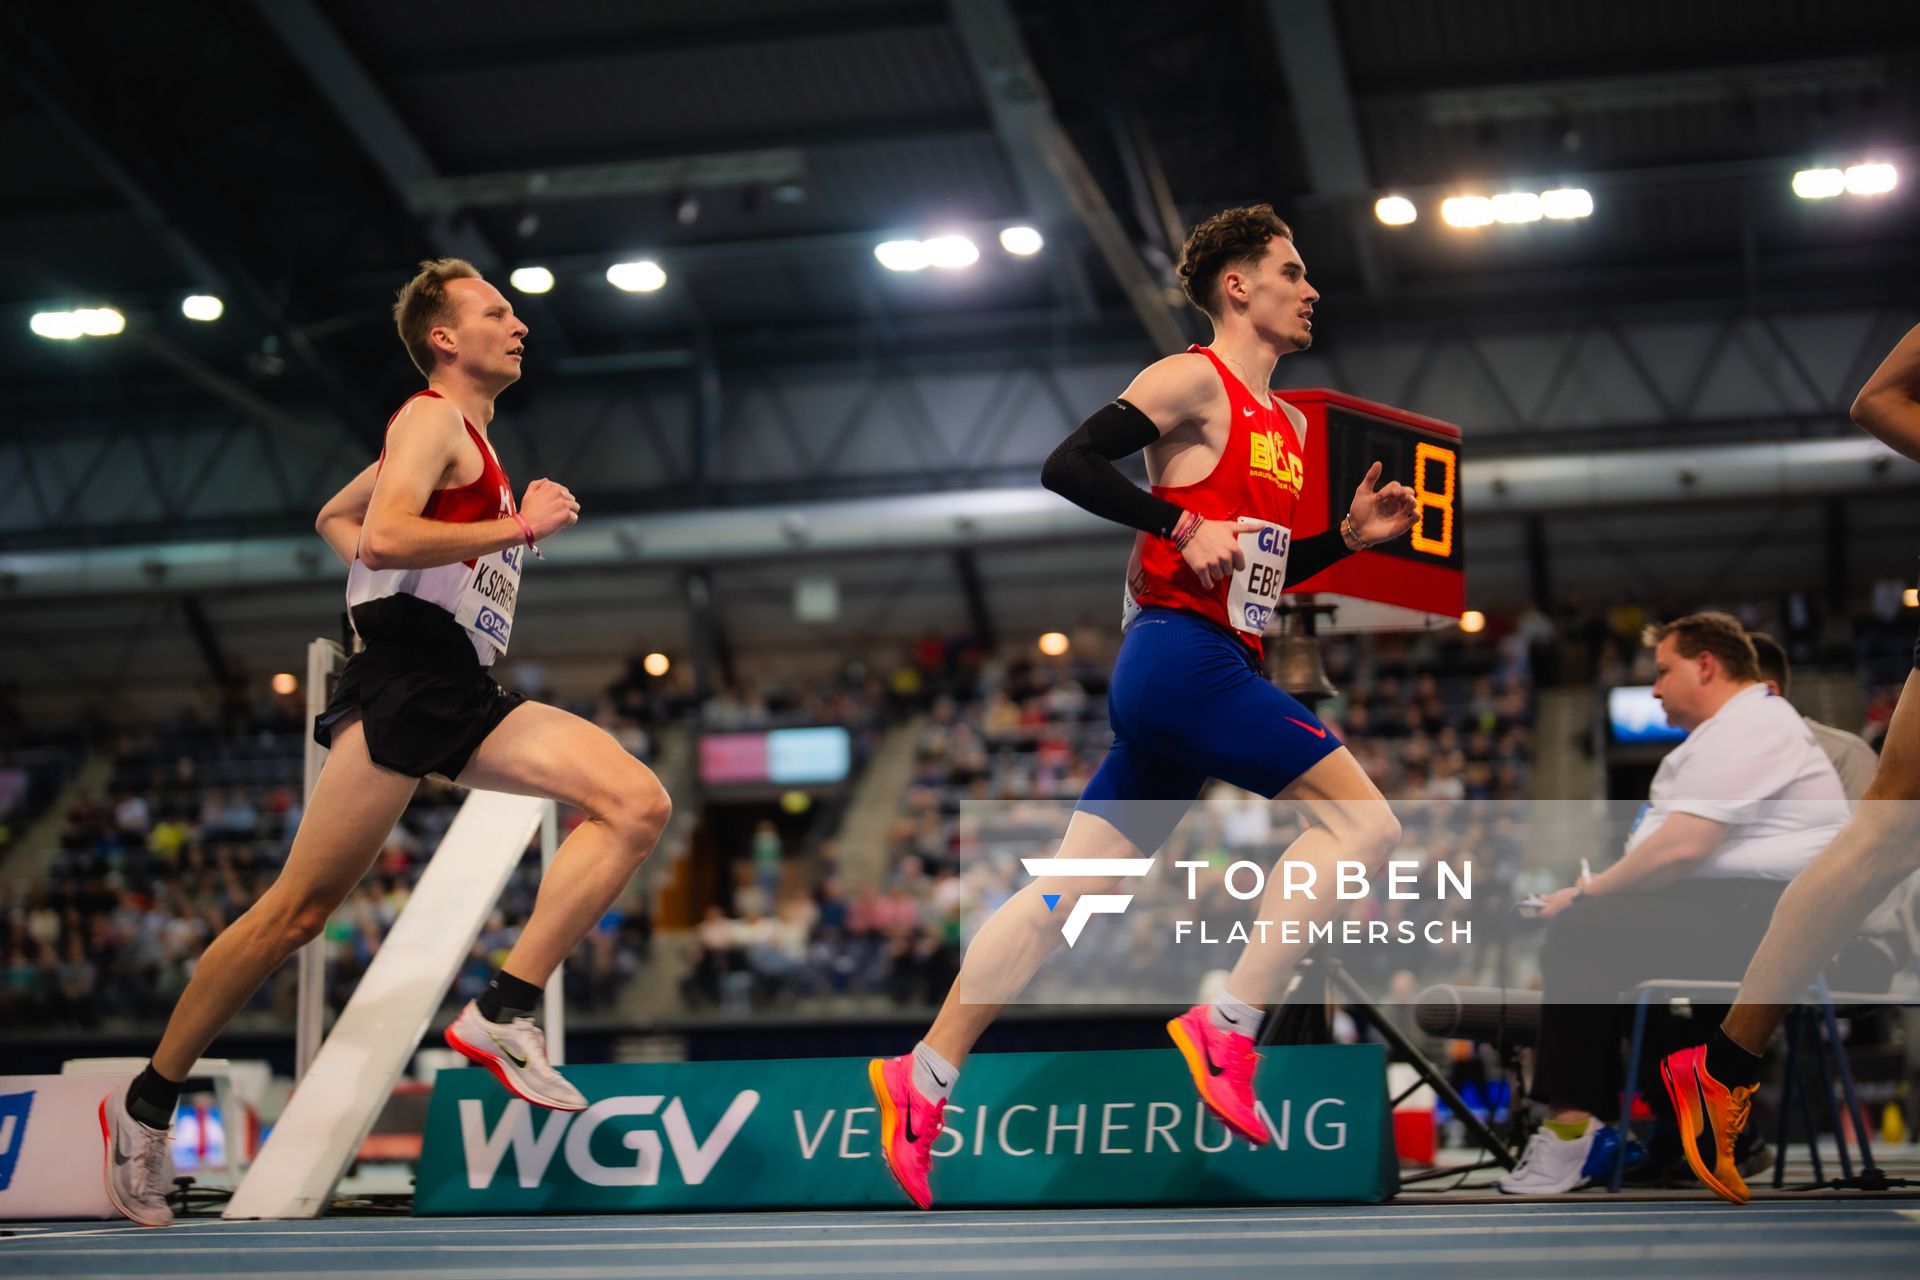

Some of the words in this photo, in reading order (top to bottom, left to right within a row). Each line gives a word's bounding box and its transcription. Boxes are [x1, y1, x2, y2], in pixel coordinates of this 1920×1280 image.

[1411, 442, 1456, 558] 8
[502, 545, 522, 576] GL
[1258, 526, 1288, 558] GLS
[459, 1089, 761, 1189] WGV
[793, 1097, 1348, 1160] VESICHERUNG
